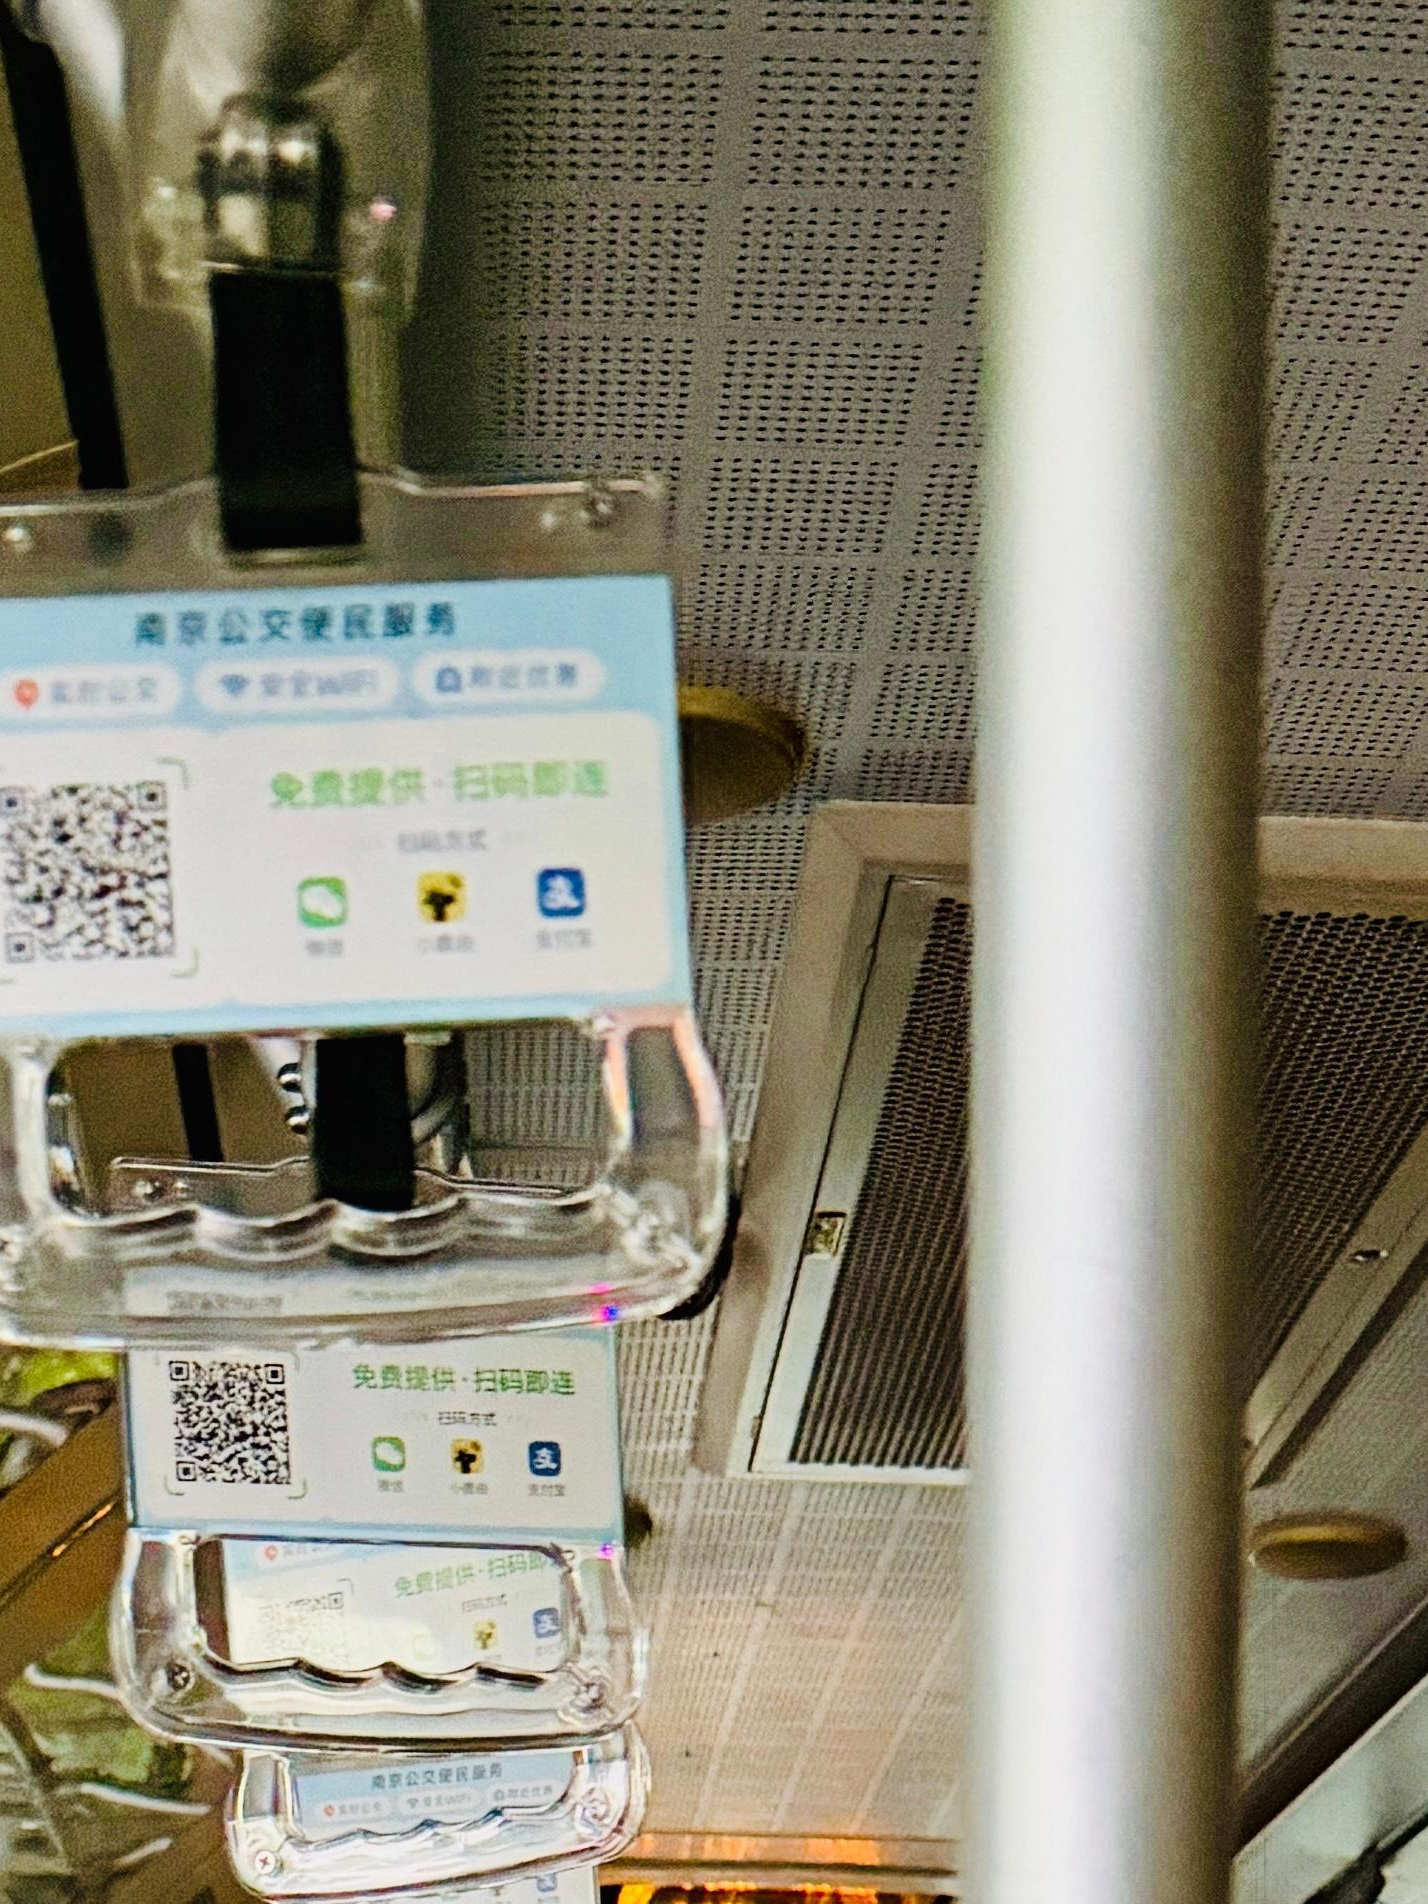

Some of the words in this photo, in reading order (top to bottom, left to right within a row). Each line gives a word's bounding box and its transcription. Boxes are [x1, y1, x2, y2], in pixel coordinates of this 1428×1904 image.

[135, 602, 455, 647] 南京公交便民服务
[372, 1762, 503, 1790] 南京公交便民服务
